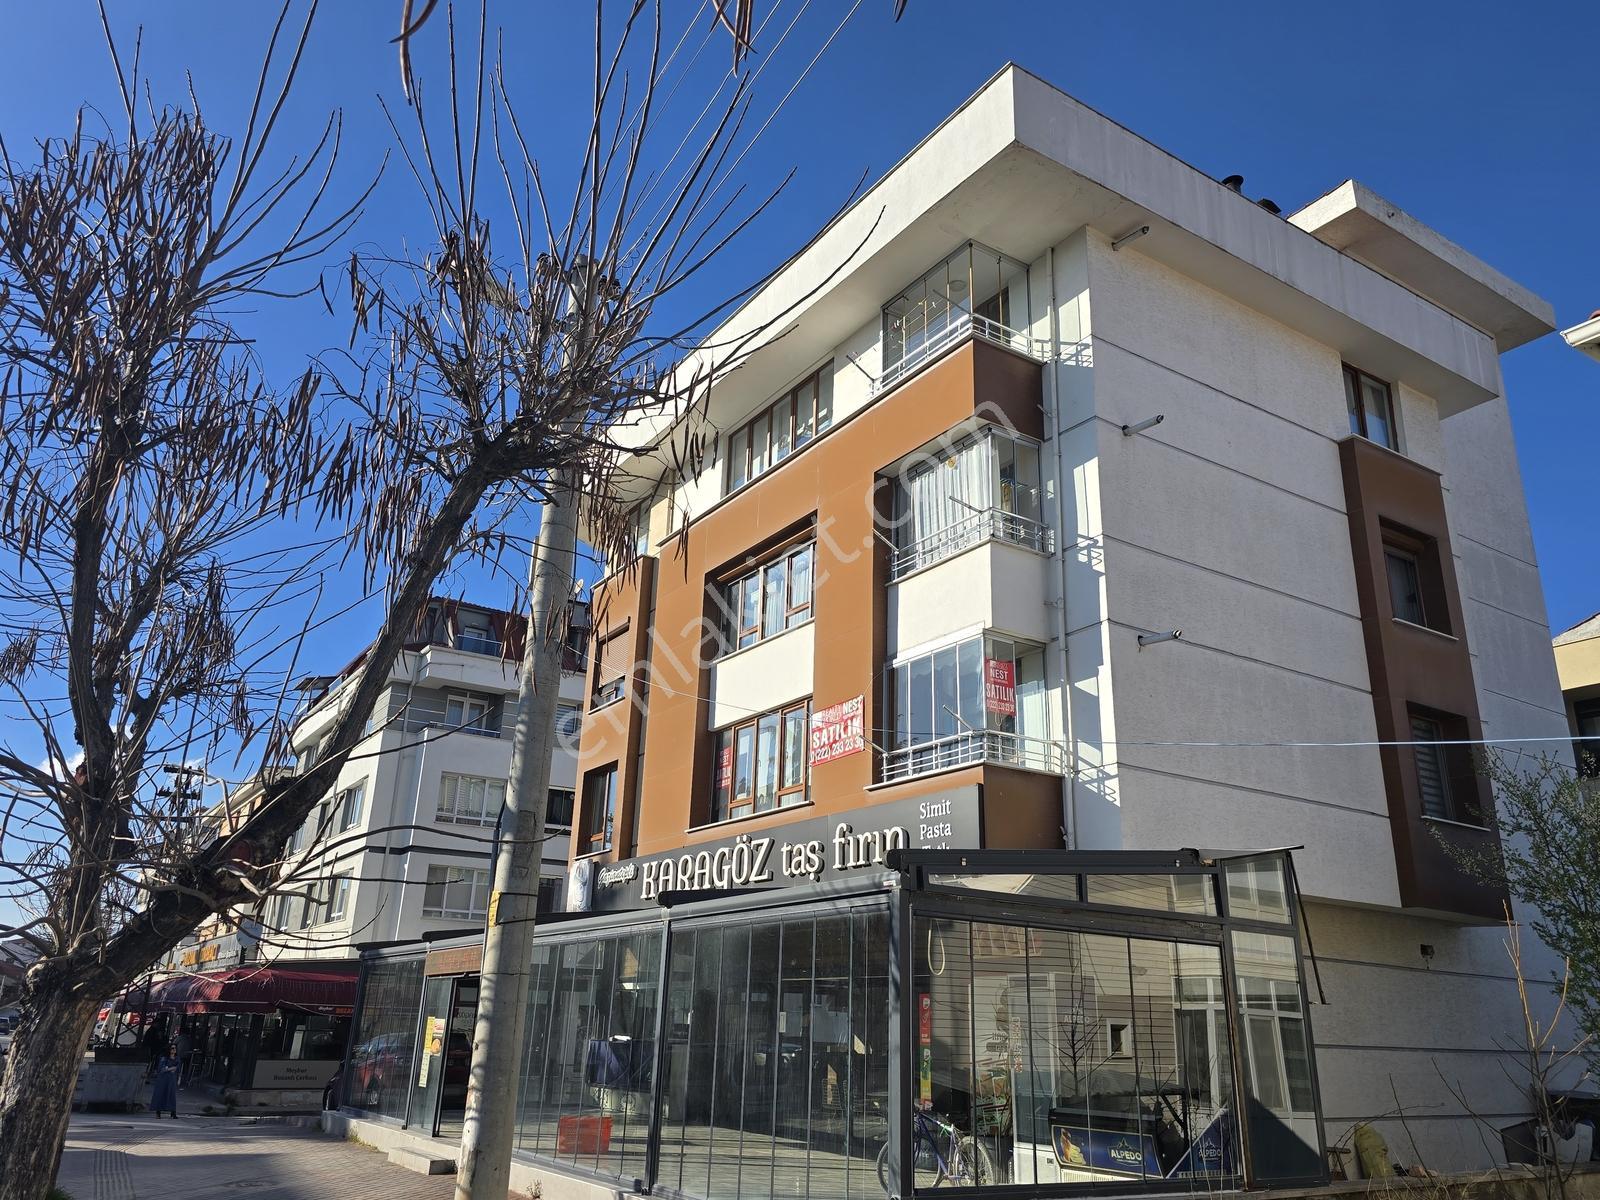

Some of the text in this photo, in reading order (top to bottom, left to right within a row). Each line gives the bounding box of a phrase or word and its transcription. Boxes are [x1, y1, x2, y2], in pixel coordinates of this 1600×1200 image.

[990, 668, 1008, 680] NEST
[986, 682, 1015, 703] SATILIK
[842, 697, 863, 715] NEST
[812, 716, 862, 749] SATILIK
[919, 799, 952, 819] Simit
[919, 822, 952, 840] Pasta
[640, 834, 772, 899] KARAGÖZ
[781, 842, 820, 880] taş
[832, 822, 904, 869] fırın
[1110, 1148, 1142, 1160] ALPEDO
